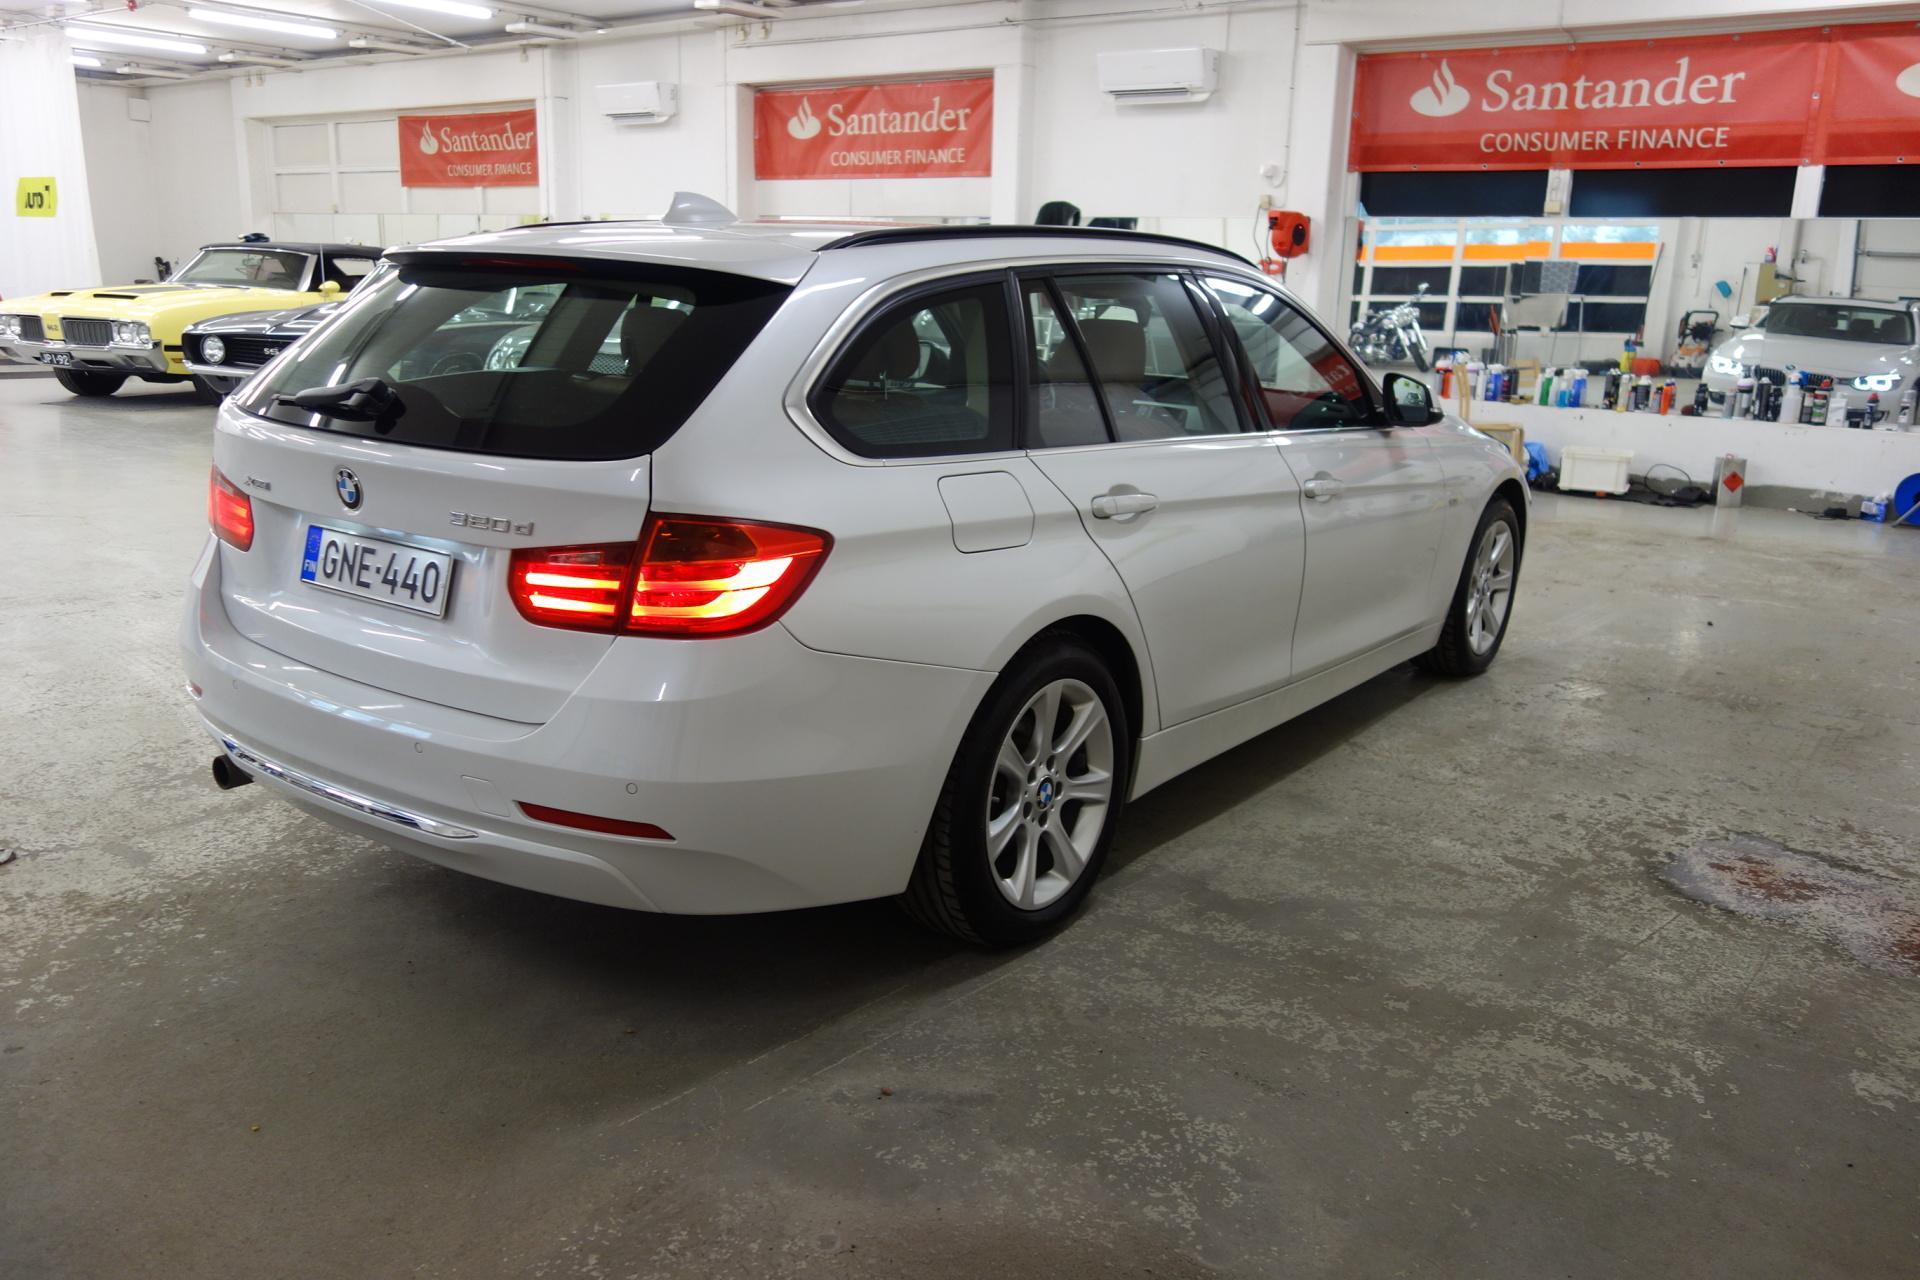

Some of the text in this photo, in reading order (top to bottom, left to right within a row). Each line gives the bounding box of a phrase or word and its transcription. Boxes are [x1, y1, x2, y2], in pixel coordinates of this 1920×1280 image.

[1481, 56, 1746, 112] Santander
[827, 96, 971, 136] Santander
[440, 121, 534, 153] Santander
[1479, 127, 1730, 152] CONSUMER FINANCE
[447, 161, 532, 177] CONSUMER FINANCE
[831, 148, 966, 166] CONSUMER FINANCE
[303, 559, 317, 573] FIN
[322, 539, 441, 604] GNE-440
